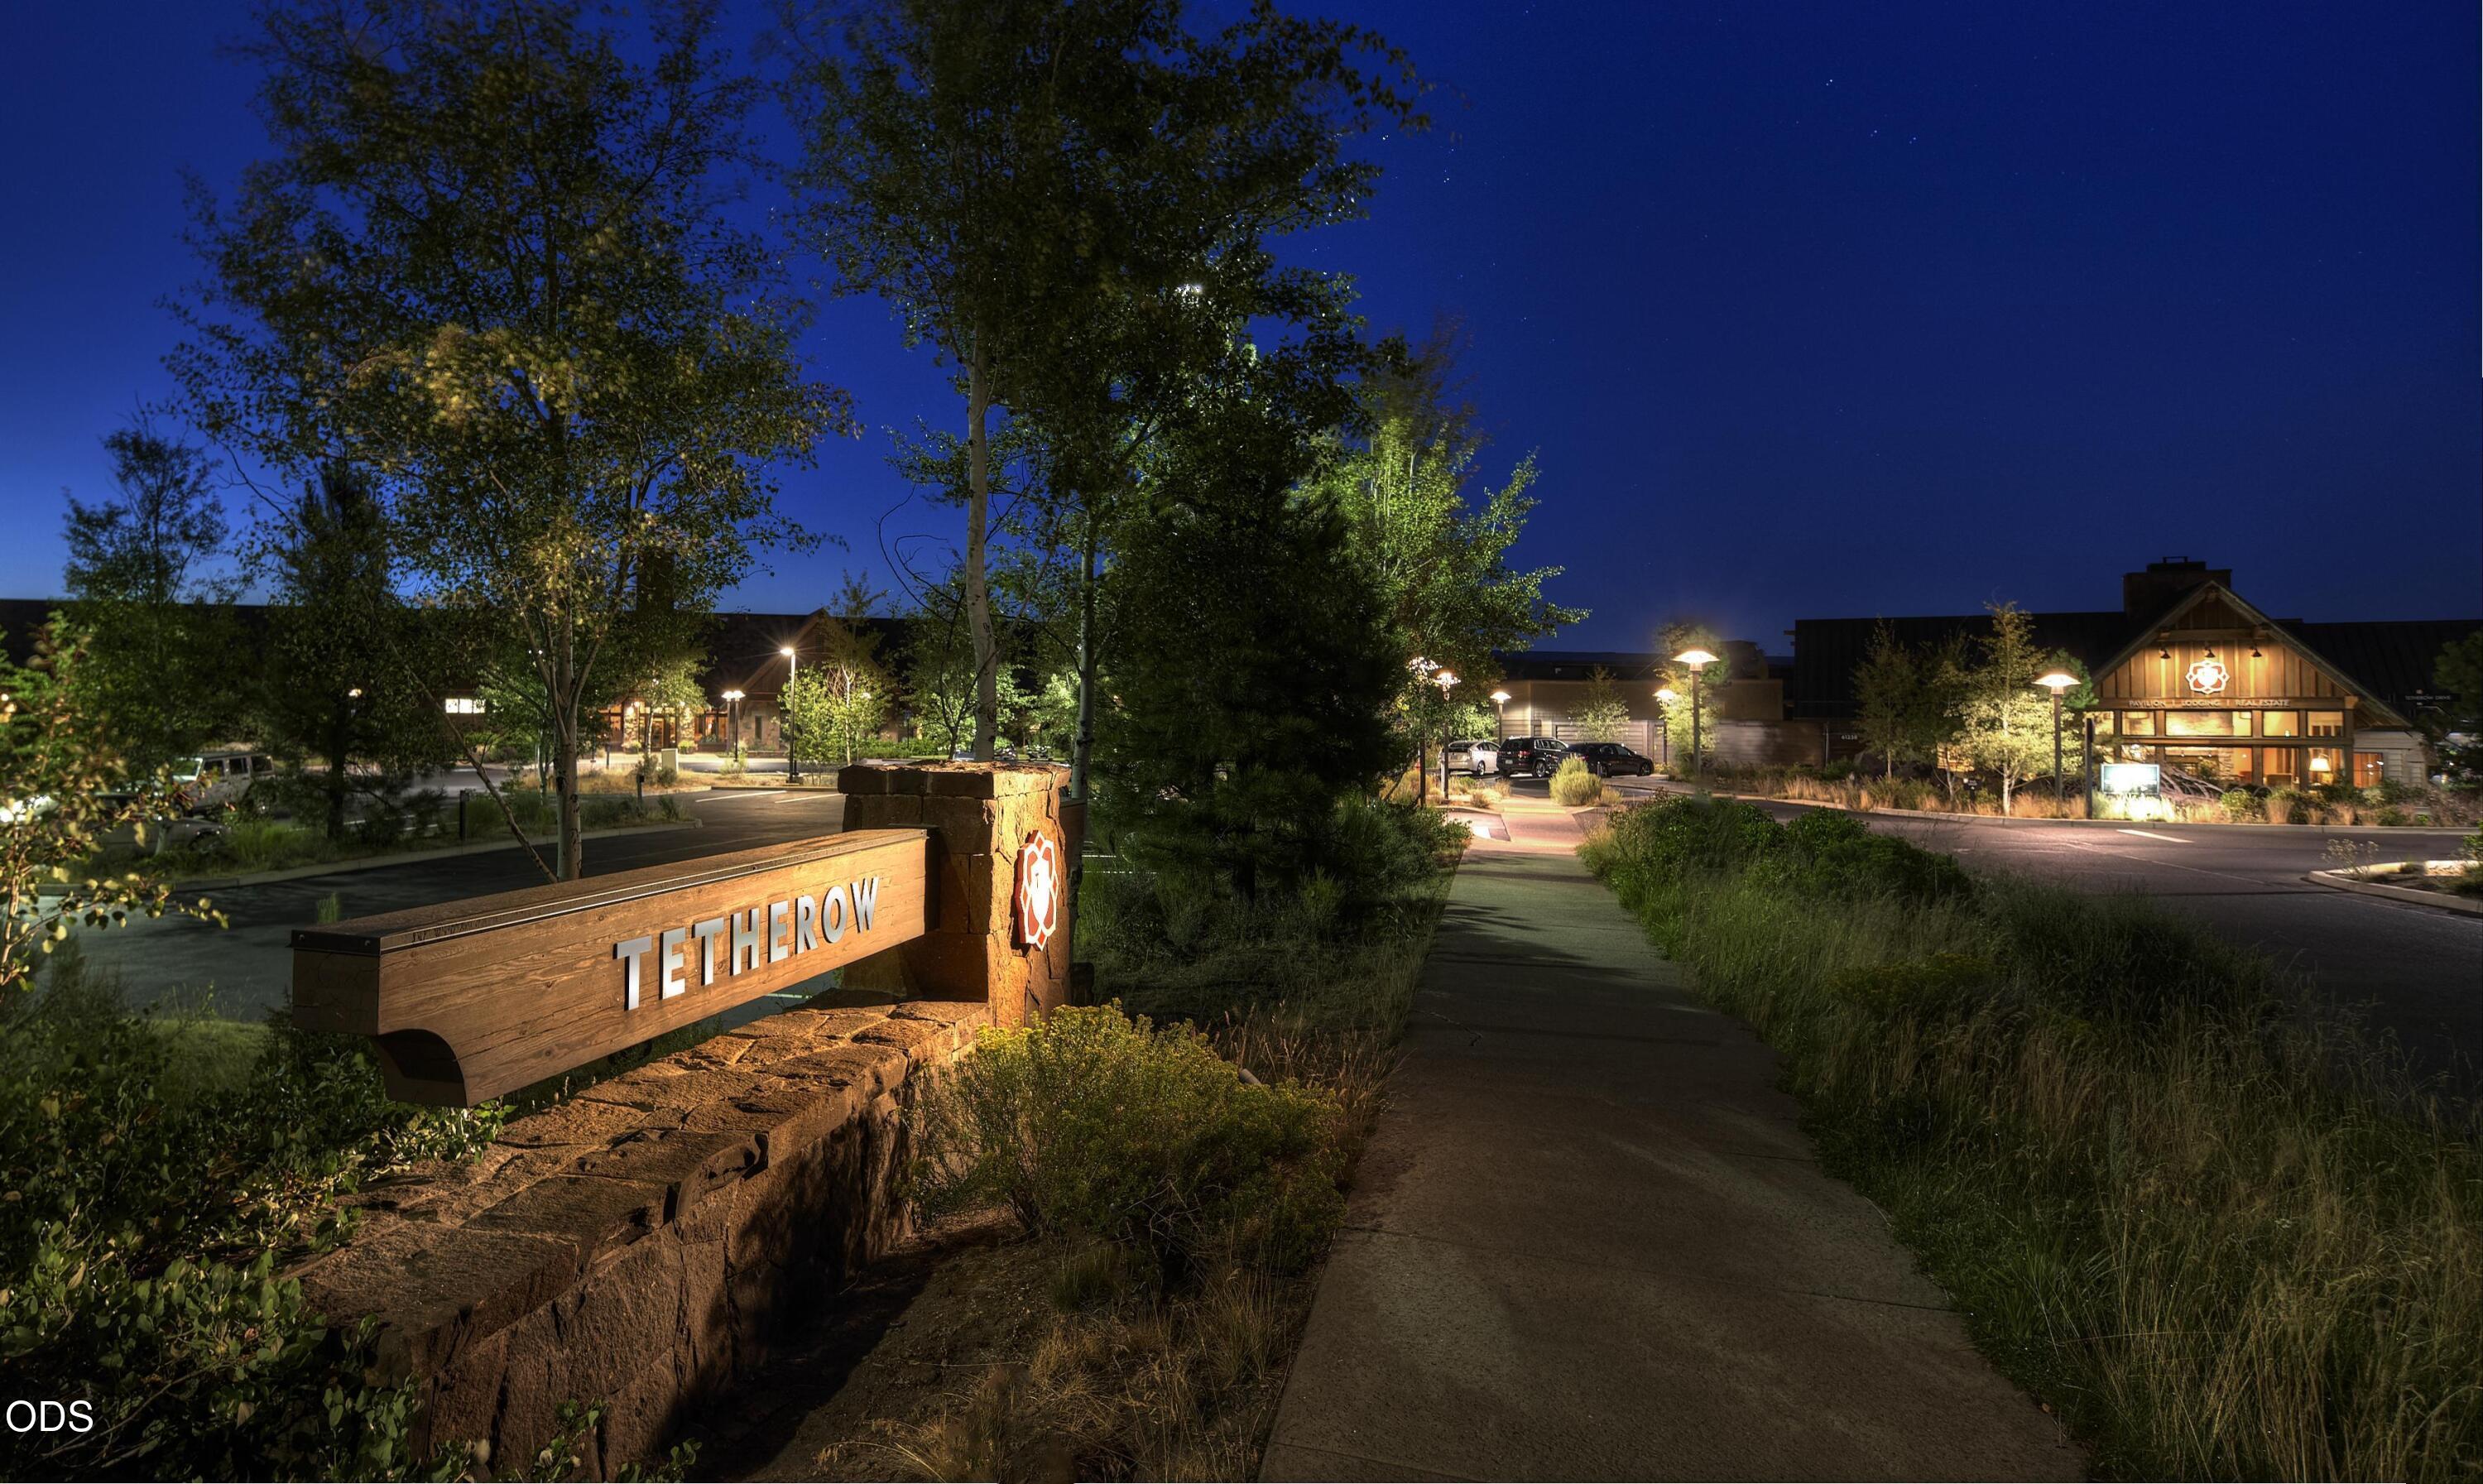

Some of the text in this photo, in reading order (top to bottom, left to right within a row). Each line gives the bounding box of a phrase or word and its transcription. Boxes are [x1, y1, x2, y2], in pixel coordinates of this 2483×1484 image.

[2129, 699, 2289, 708] PAVILION LODGING REAL ESTATE
[612, 876, 880, 1011] TETHEROW
